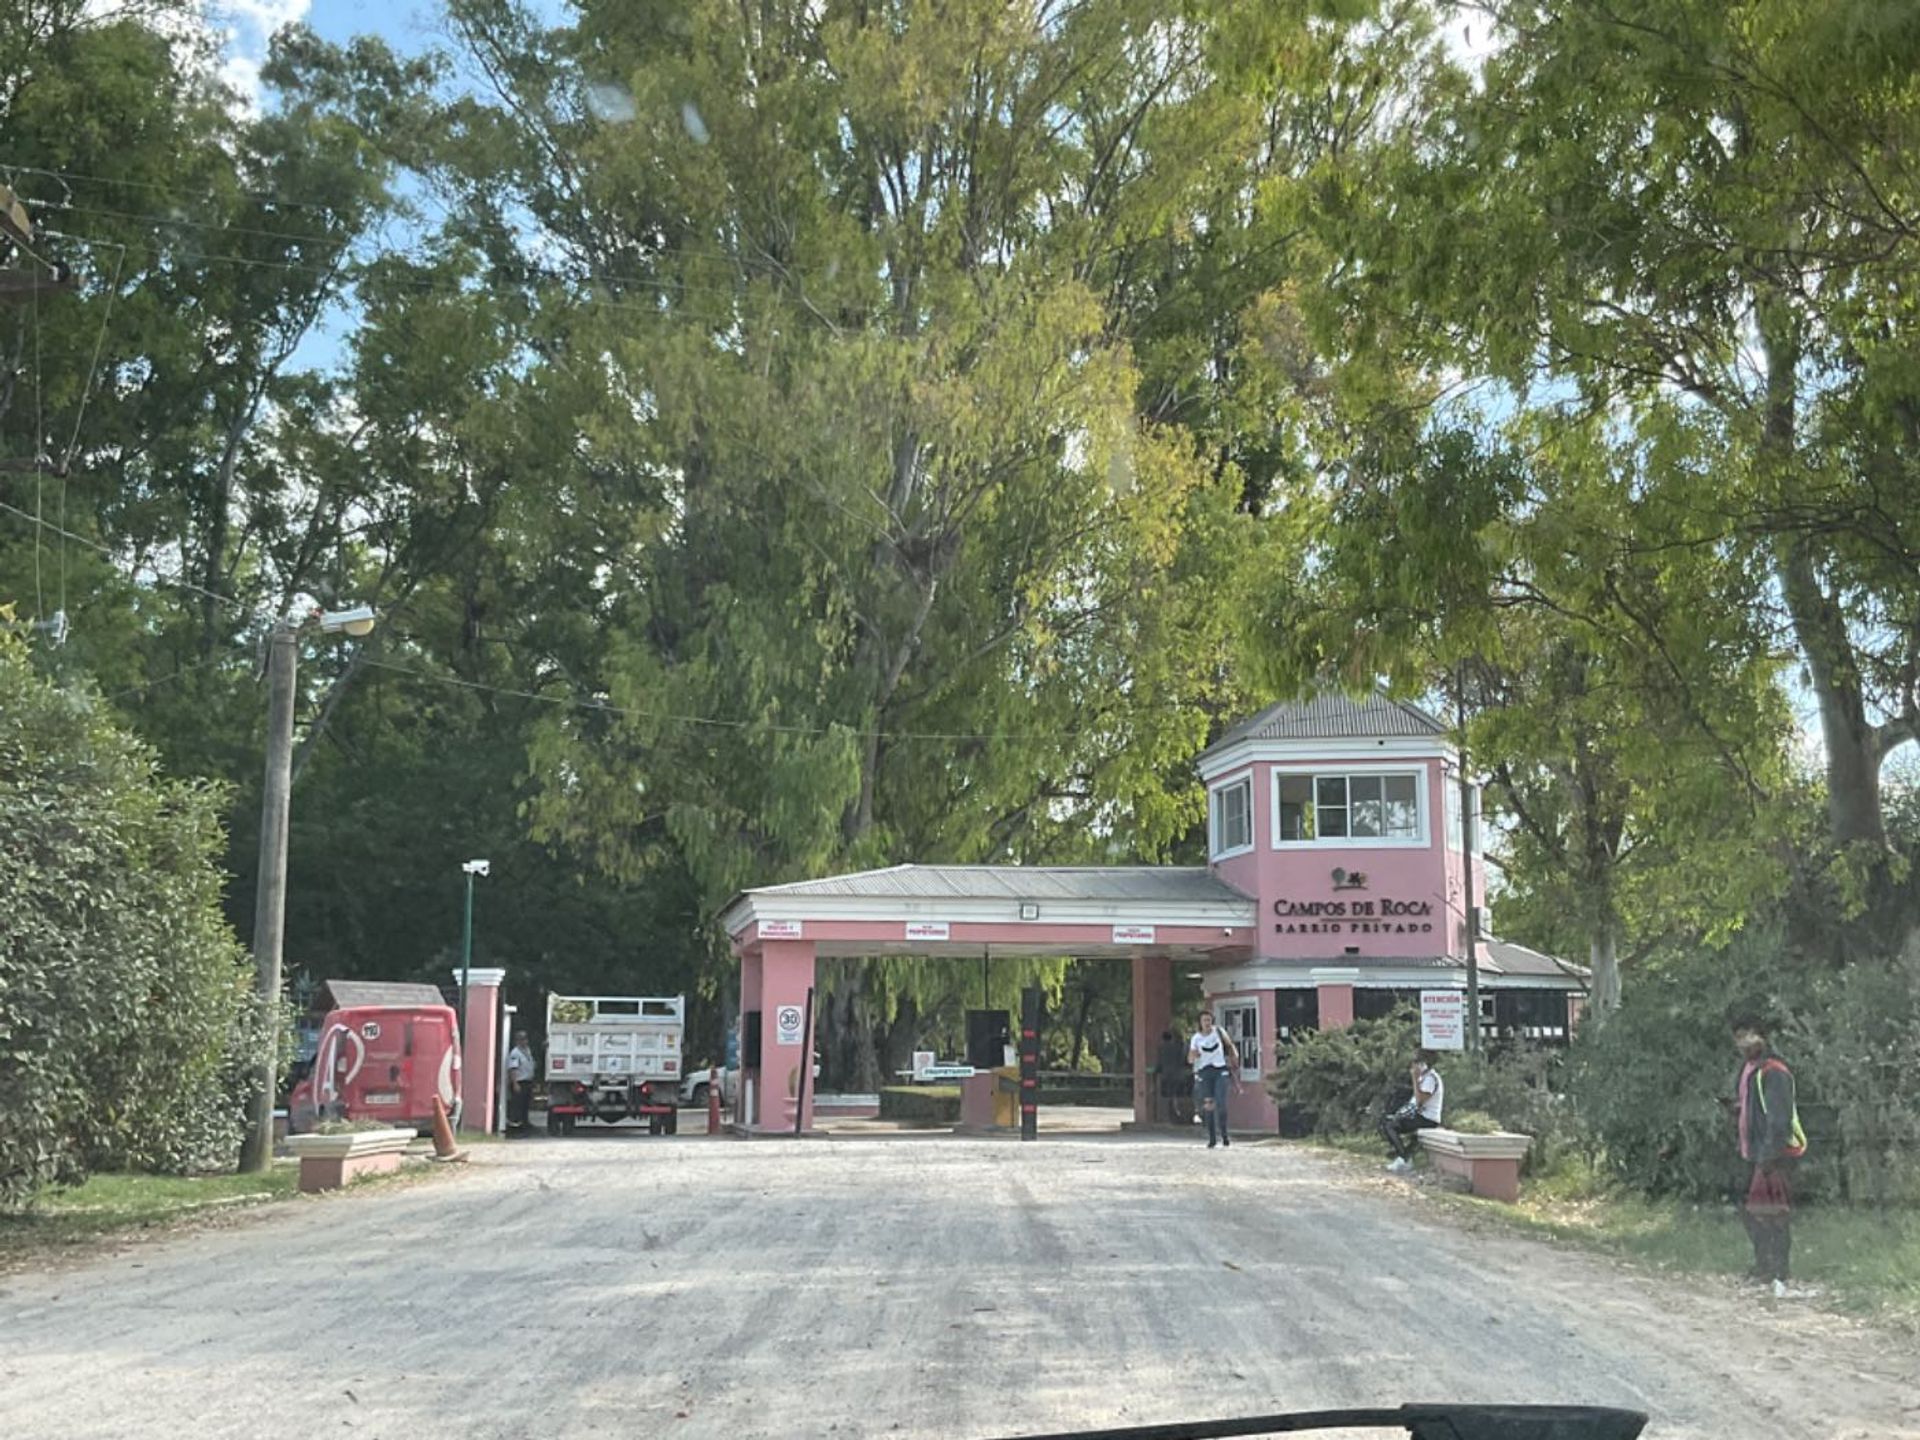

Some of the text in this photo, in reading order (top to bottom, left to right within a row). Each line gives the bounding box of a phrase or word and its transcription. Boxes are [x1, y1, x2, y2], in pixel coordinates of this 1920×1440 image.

[1274, 899, 1430, 916] CAMPOS DE ROCA
[1275, 923, 1432, 933] BARRIO PRIVADO
[783, 1013, 797, 1025] 30
